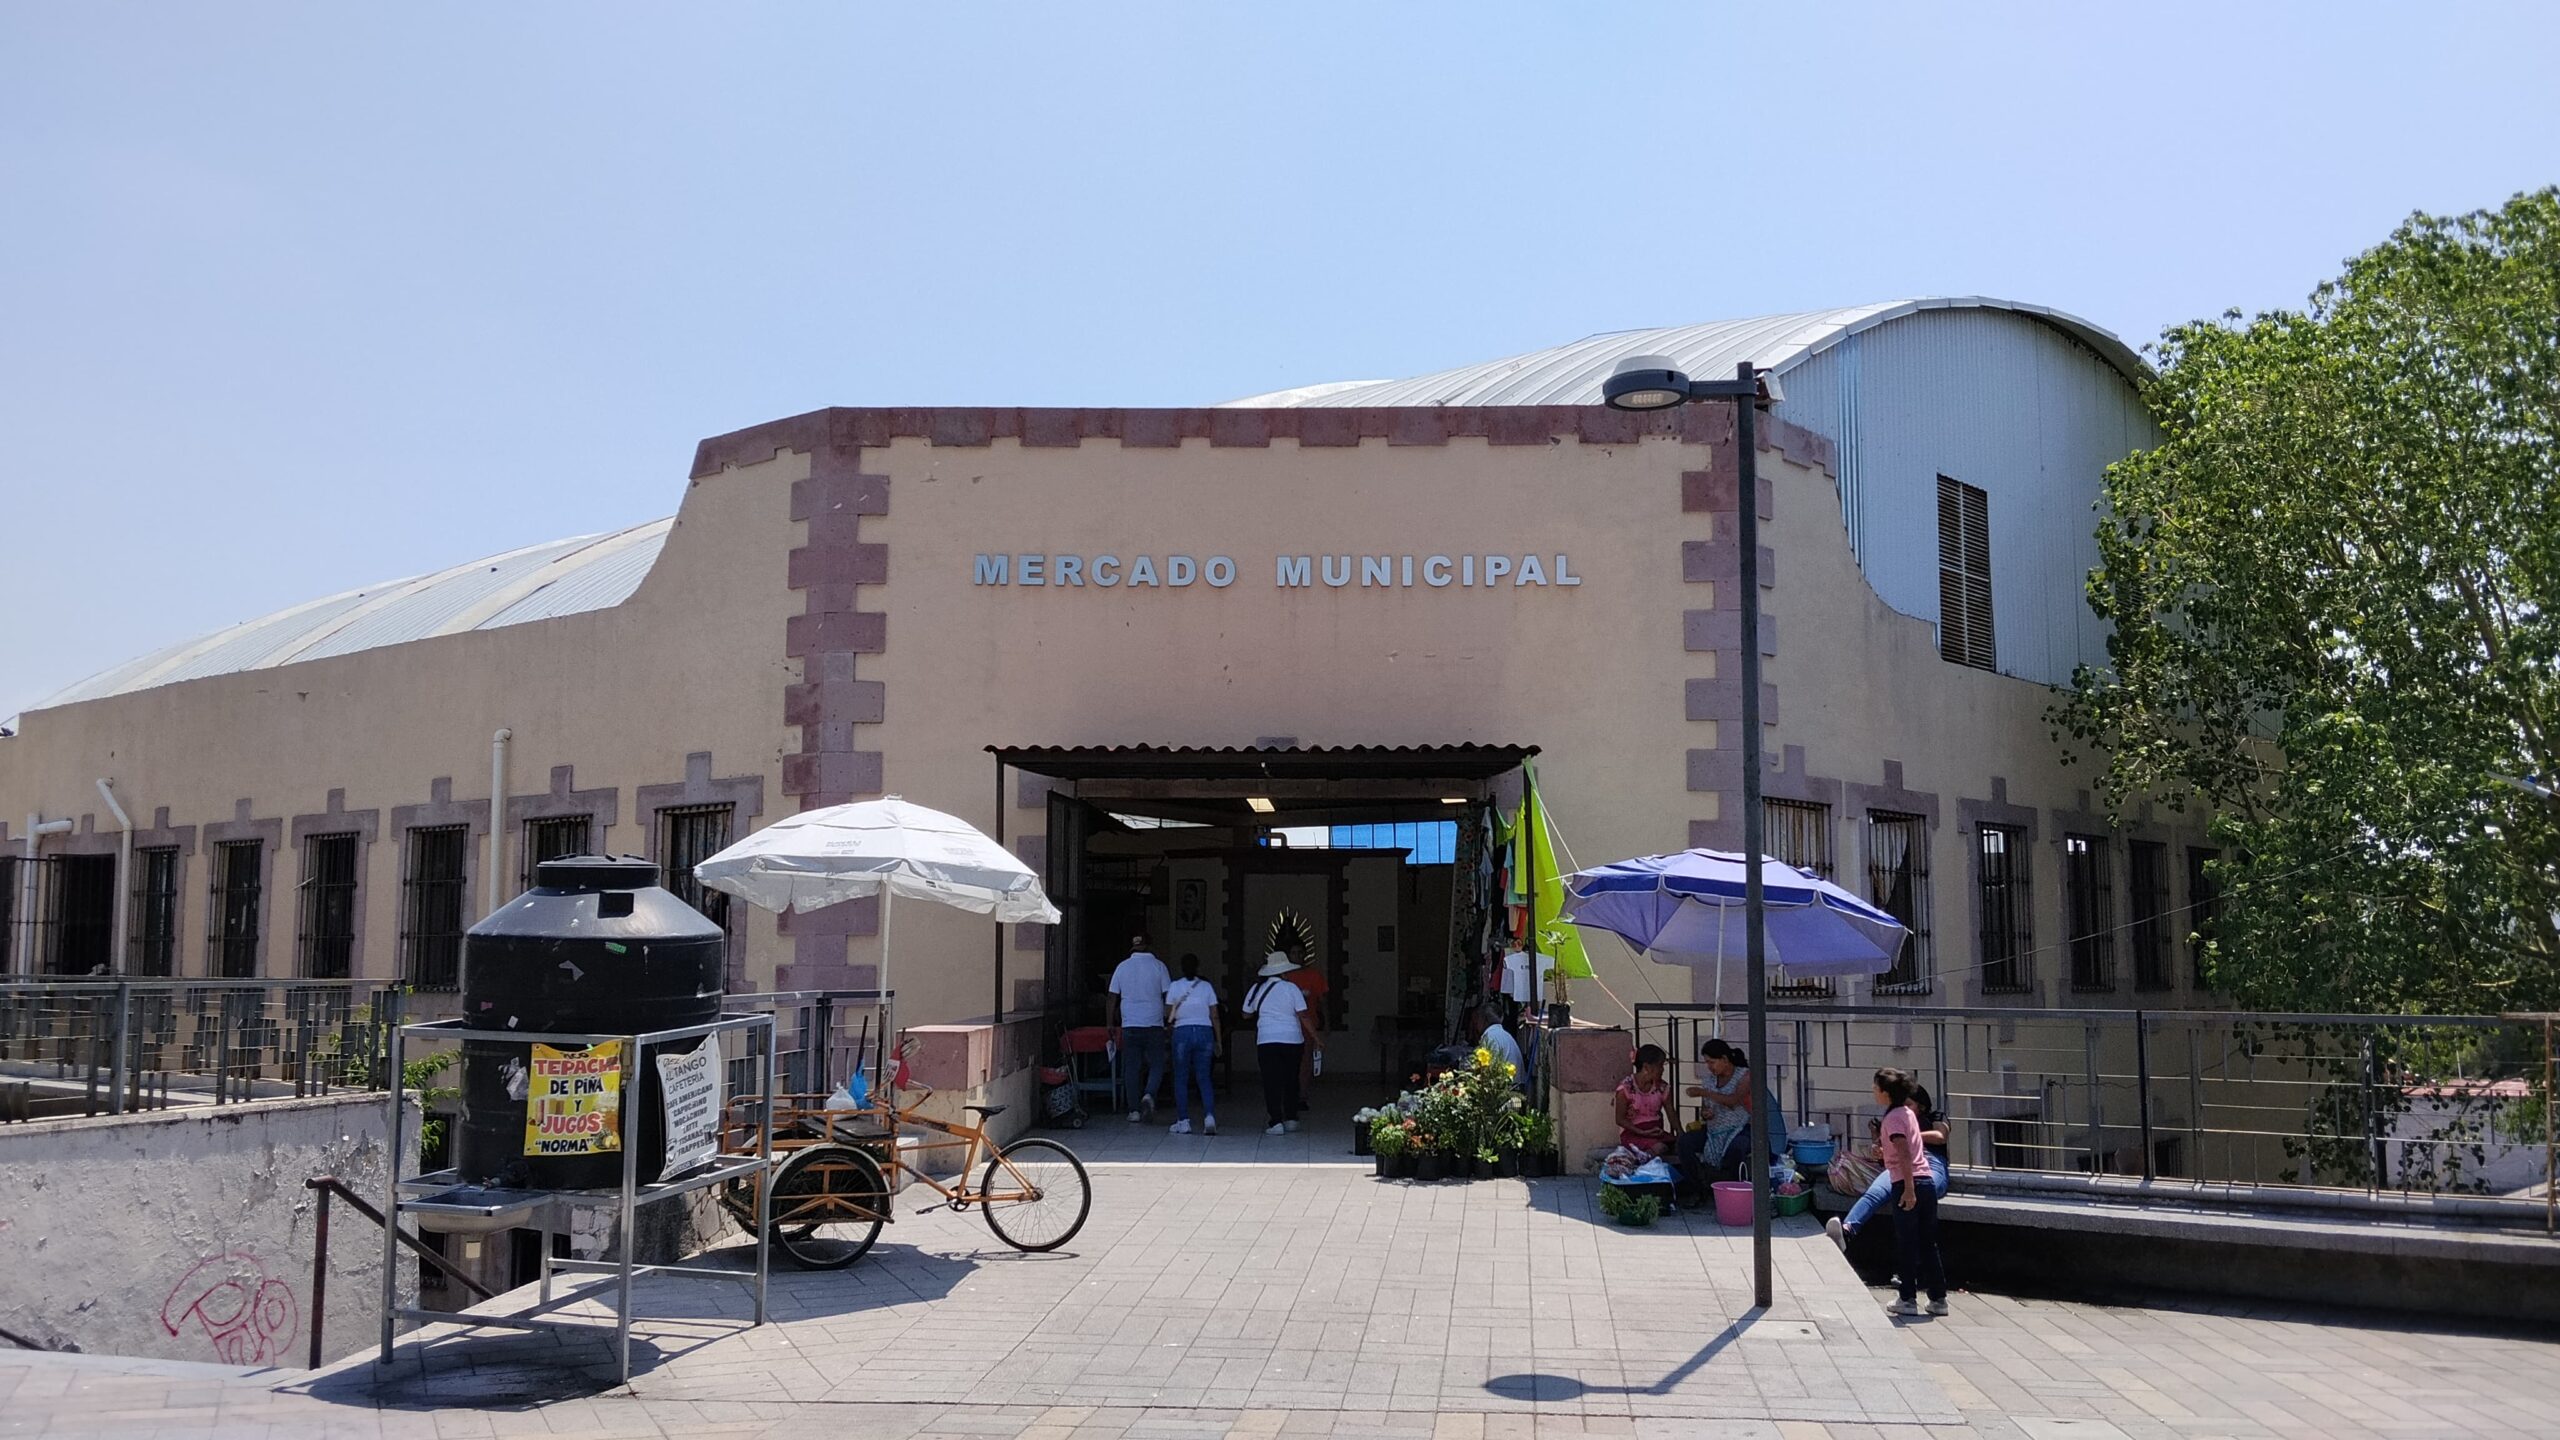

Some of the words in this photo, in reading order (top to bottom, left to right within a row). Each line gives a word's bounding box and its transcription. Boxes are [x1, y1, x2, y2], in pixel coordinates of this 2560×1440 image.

[973, 554, 1237, 587] MERCADO
[1276, 554, 1581, 586] MUNICIPAL
[673, 1057, 706, 1077] TANGO
[550, 1080, 568, 1094] DE
[679, 1083, 713, 1103] AMERICANO
[574, 1099, 582, 1112] Y
[542, 1113, 601, 1134] JUGOS
